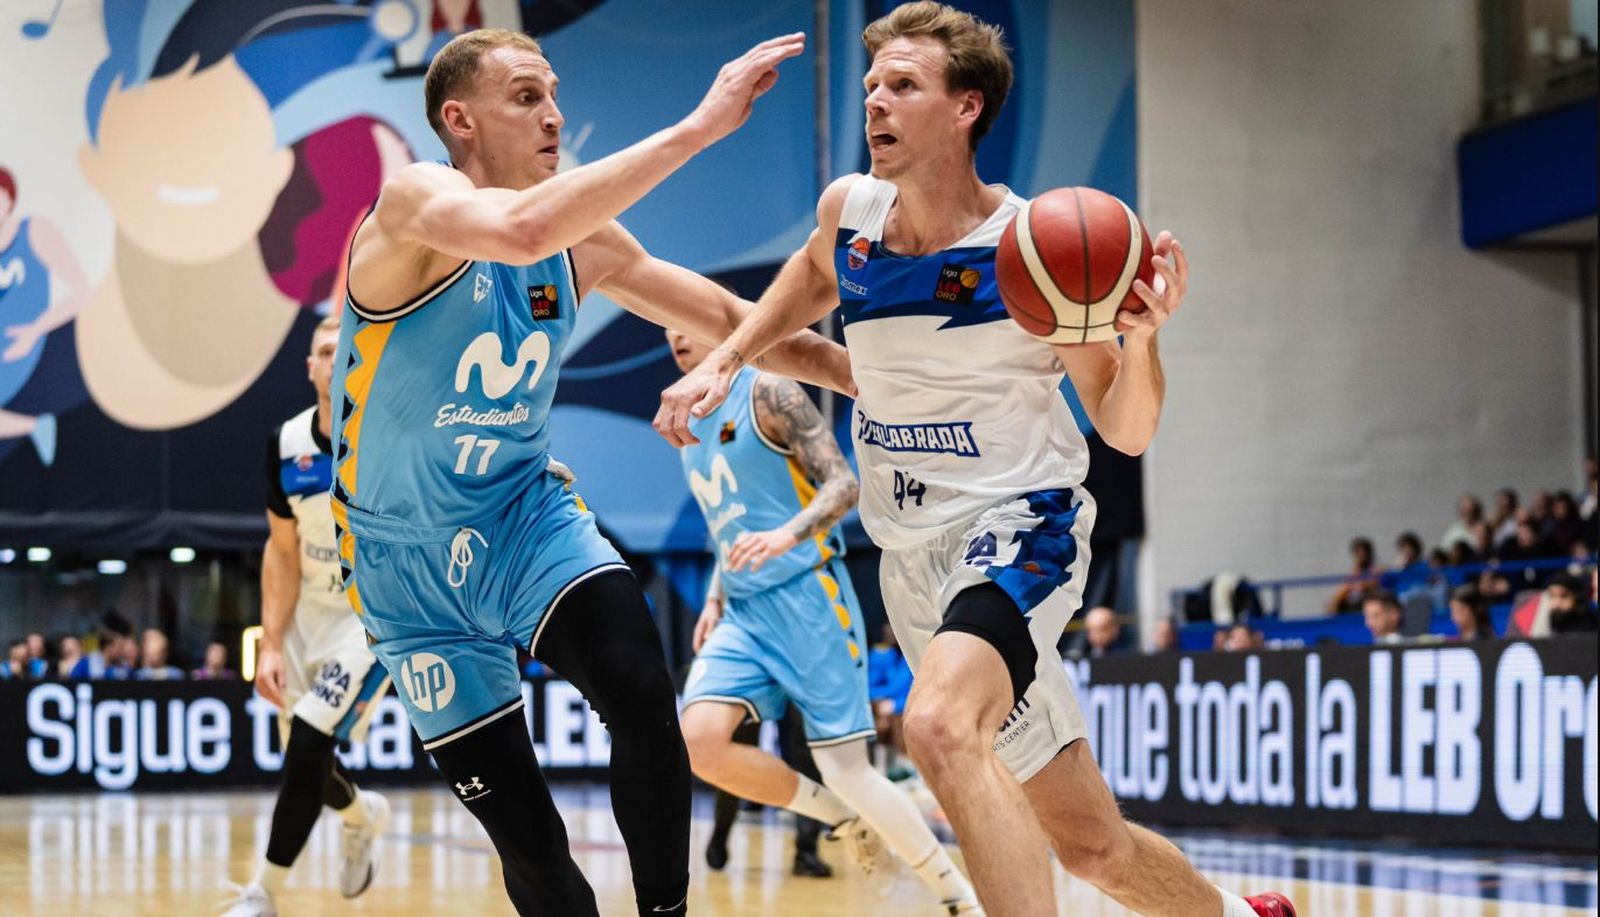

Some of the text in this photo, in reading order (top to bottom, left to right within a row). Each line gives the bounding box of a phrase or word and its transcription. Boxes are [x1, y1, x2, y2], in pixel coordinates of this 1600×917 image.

[533, 309, 550, 317] ORO
[936, 290, 957, 301] ORO
[434, 402, 529, 428] Estudiantes
[454, 435, 501, 475] 17
[894, 469, 927, 511] 44
[403, 653, 455, 712] hp
[26, 682, 415, 791] Sigue ta
[1004, 720, 1030, 744] CENTER
[1062, 658, 1170, 801] igue
[1174, 655, 1295, 807] toda
[1305, 652, 1358, 811] la
[1368, 646, 1483, 816] LEB
